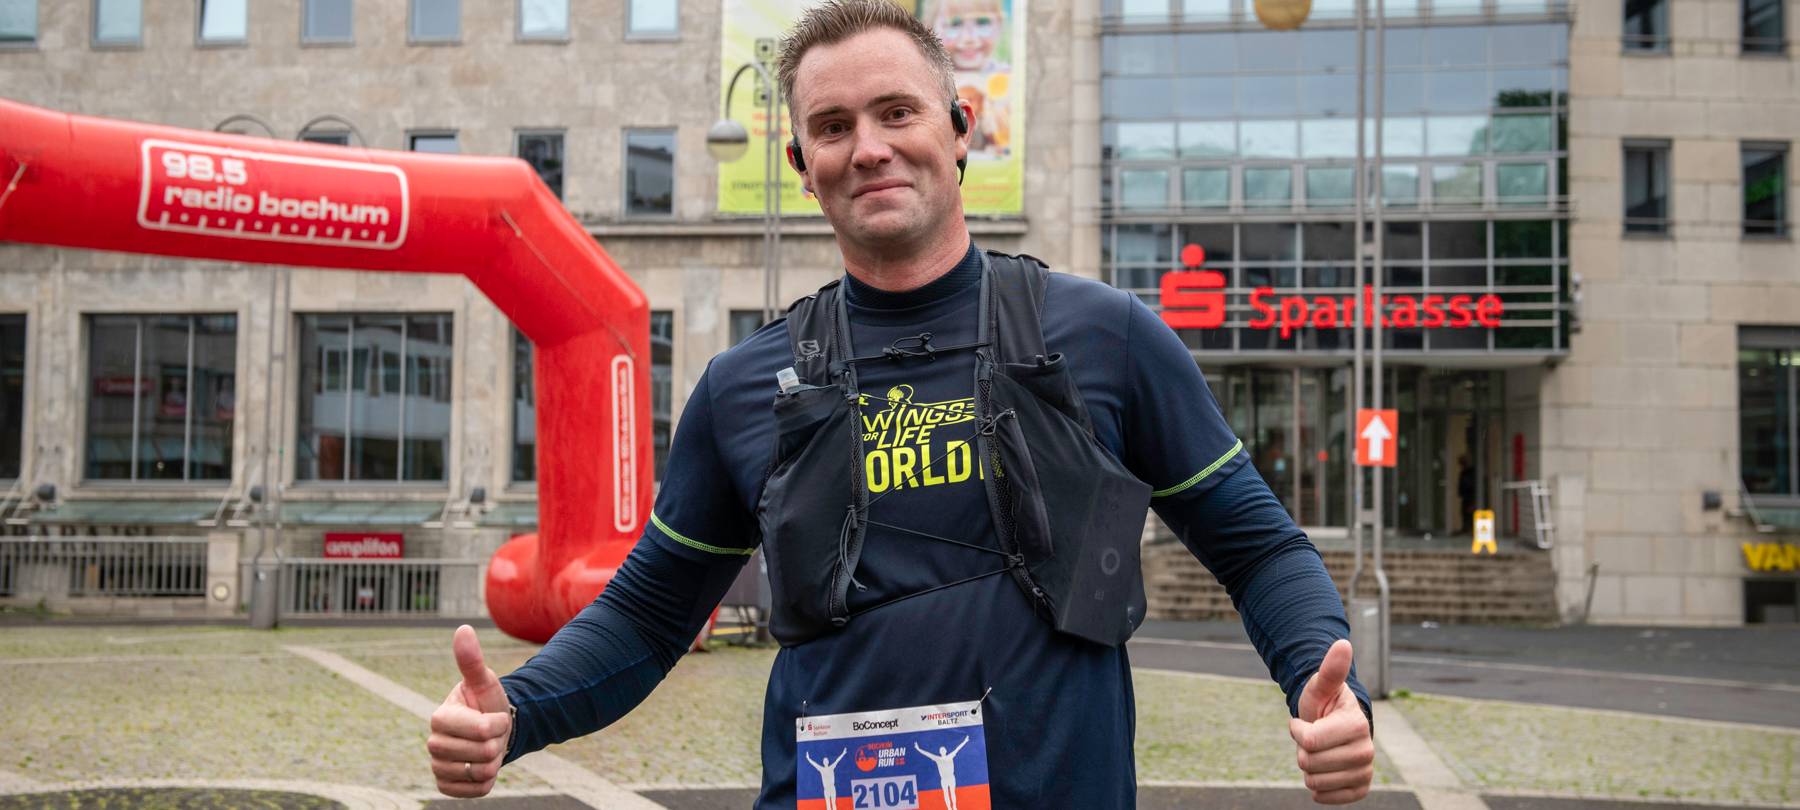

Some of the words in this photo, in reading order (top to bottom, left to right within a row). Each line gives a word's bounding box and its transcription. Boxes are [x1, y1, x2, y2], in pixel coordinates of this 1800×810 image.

[161, 151, 248, 186] 98.5
[163, 186, 254, 214] radio
[258, 191, 390, 226] bochum
[1249, 284, 1504, 340] Sparkasse
[862, 402, 967, 433] WINGS
[862, 432, 879, 442] OR
[876, 424, 936, 450] LIFE
[864, 440, 972, 494] ORLD
[326, 536, 400, 558] amplifon
[852, 718, 899, 731] BoConcept
[927, 710, 968, 721] INTERSPORT
[937, 717, 959, 726] BALTZ
[878, 747, 906, 758] URBAN
[878, 757, 895, 767] RUN
[853, 780, 917, 809] 2104
